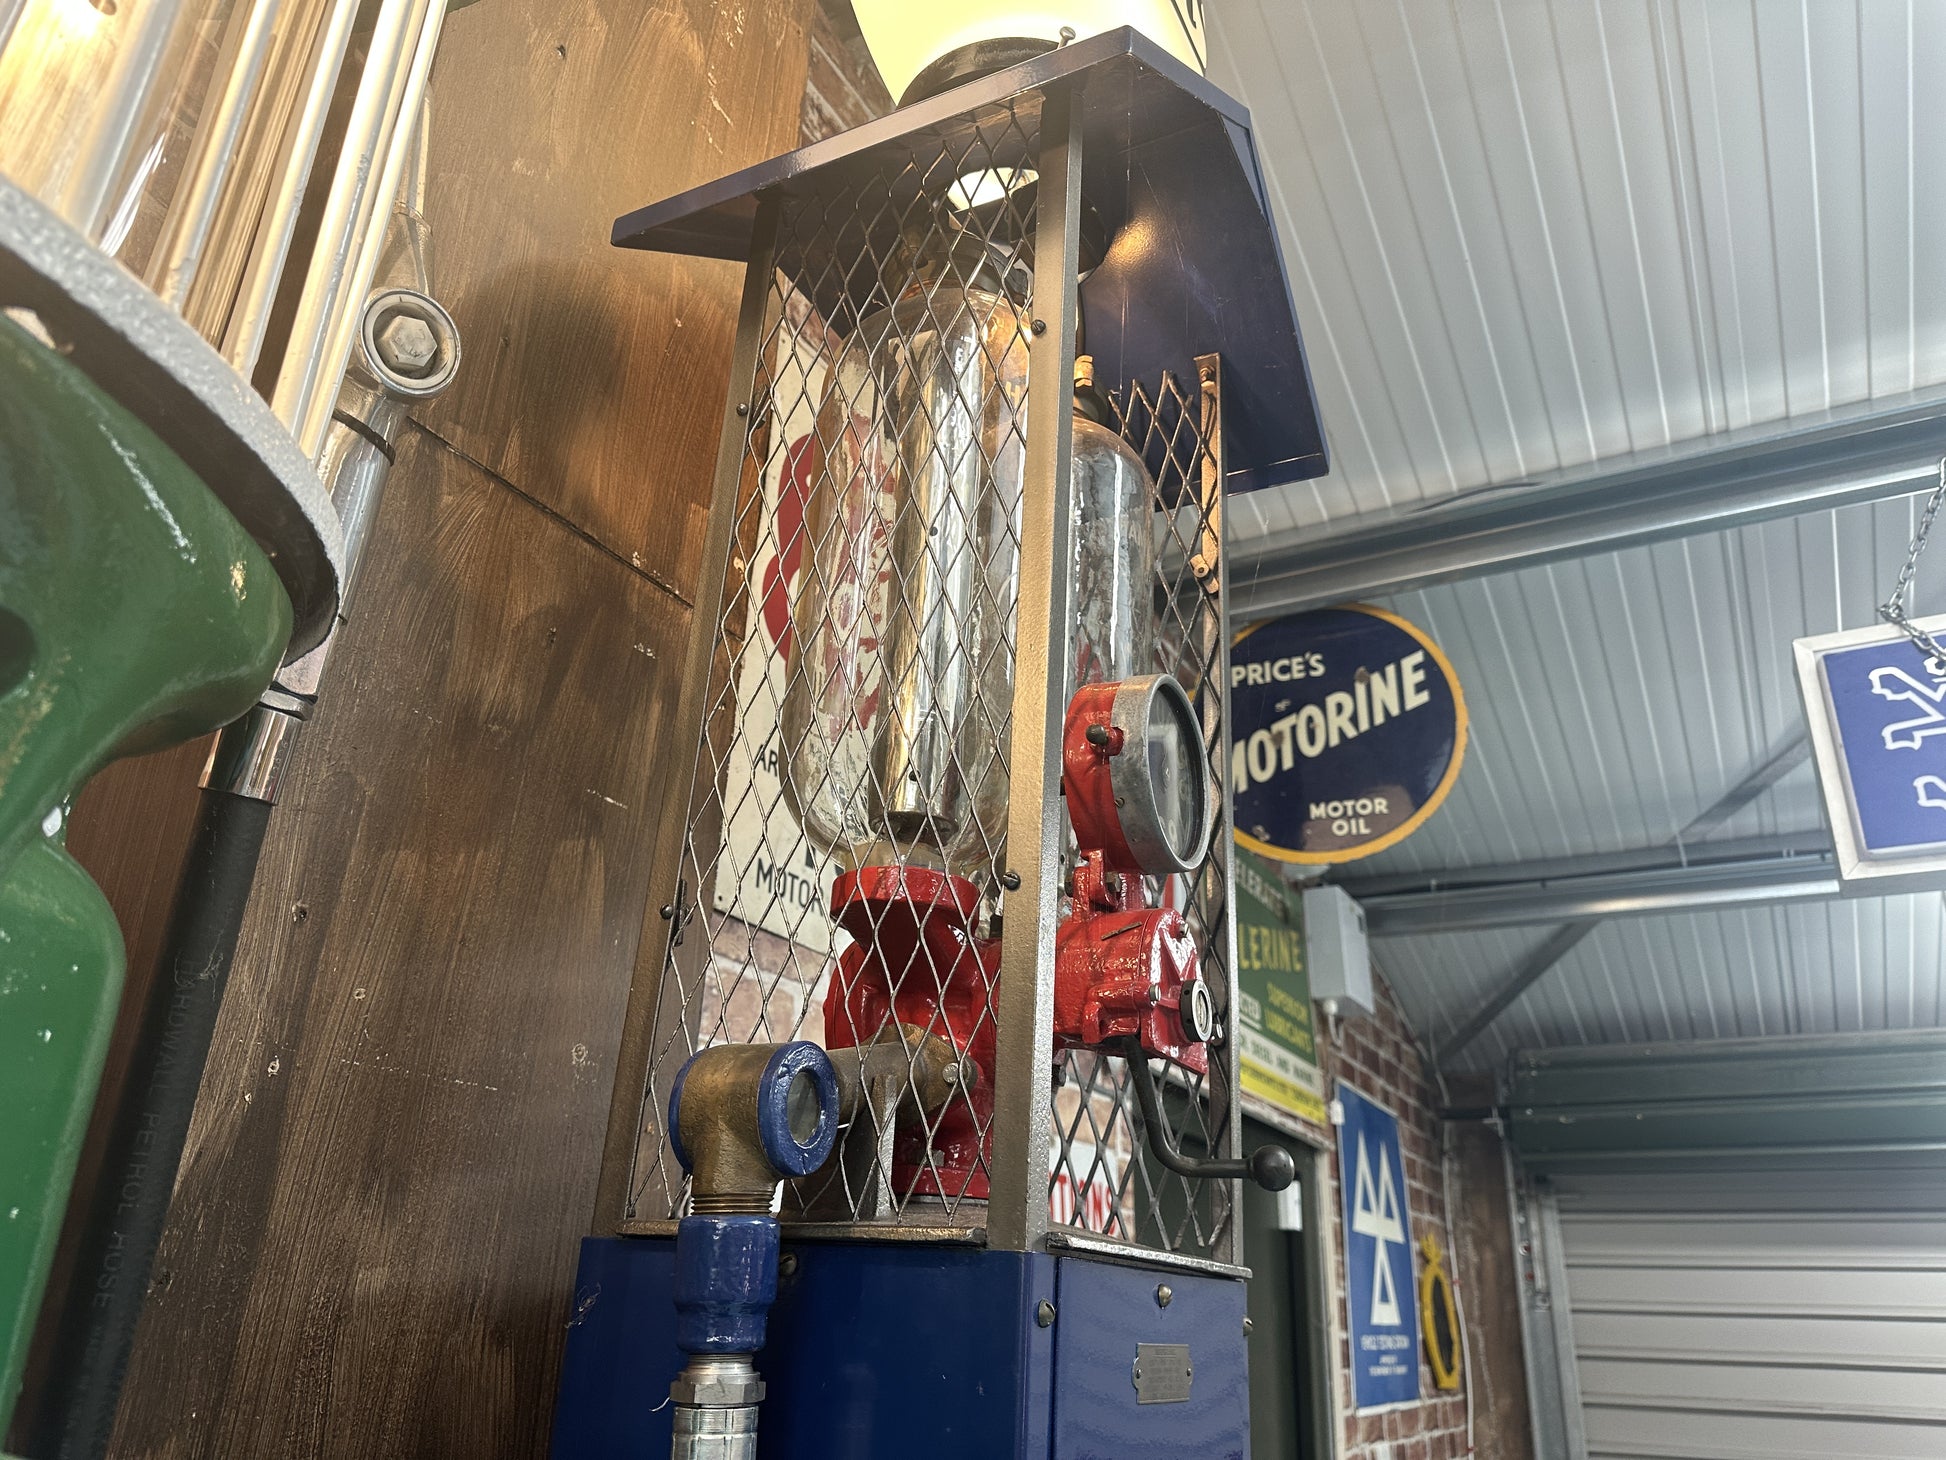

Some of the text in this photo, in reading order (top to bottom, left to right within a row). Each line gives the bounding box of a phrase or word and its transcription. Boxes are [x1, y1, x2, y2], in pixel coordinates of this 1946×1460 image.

[1231, 651, 1326, 688] PRICE'S
[1231, 650, 1430, 795] MOTORINE
[1309, 797, 1389, 820] MOTOR
[1331, 819, 1371, 836] OIL
[1238, 923, 1303, 972] LERINE
[117, 1111, 160, 1217] PETROL
[93, 1230, 130, 1309] HOSE
